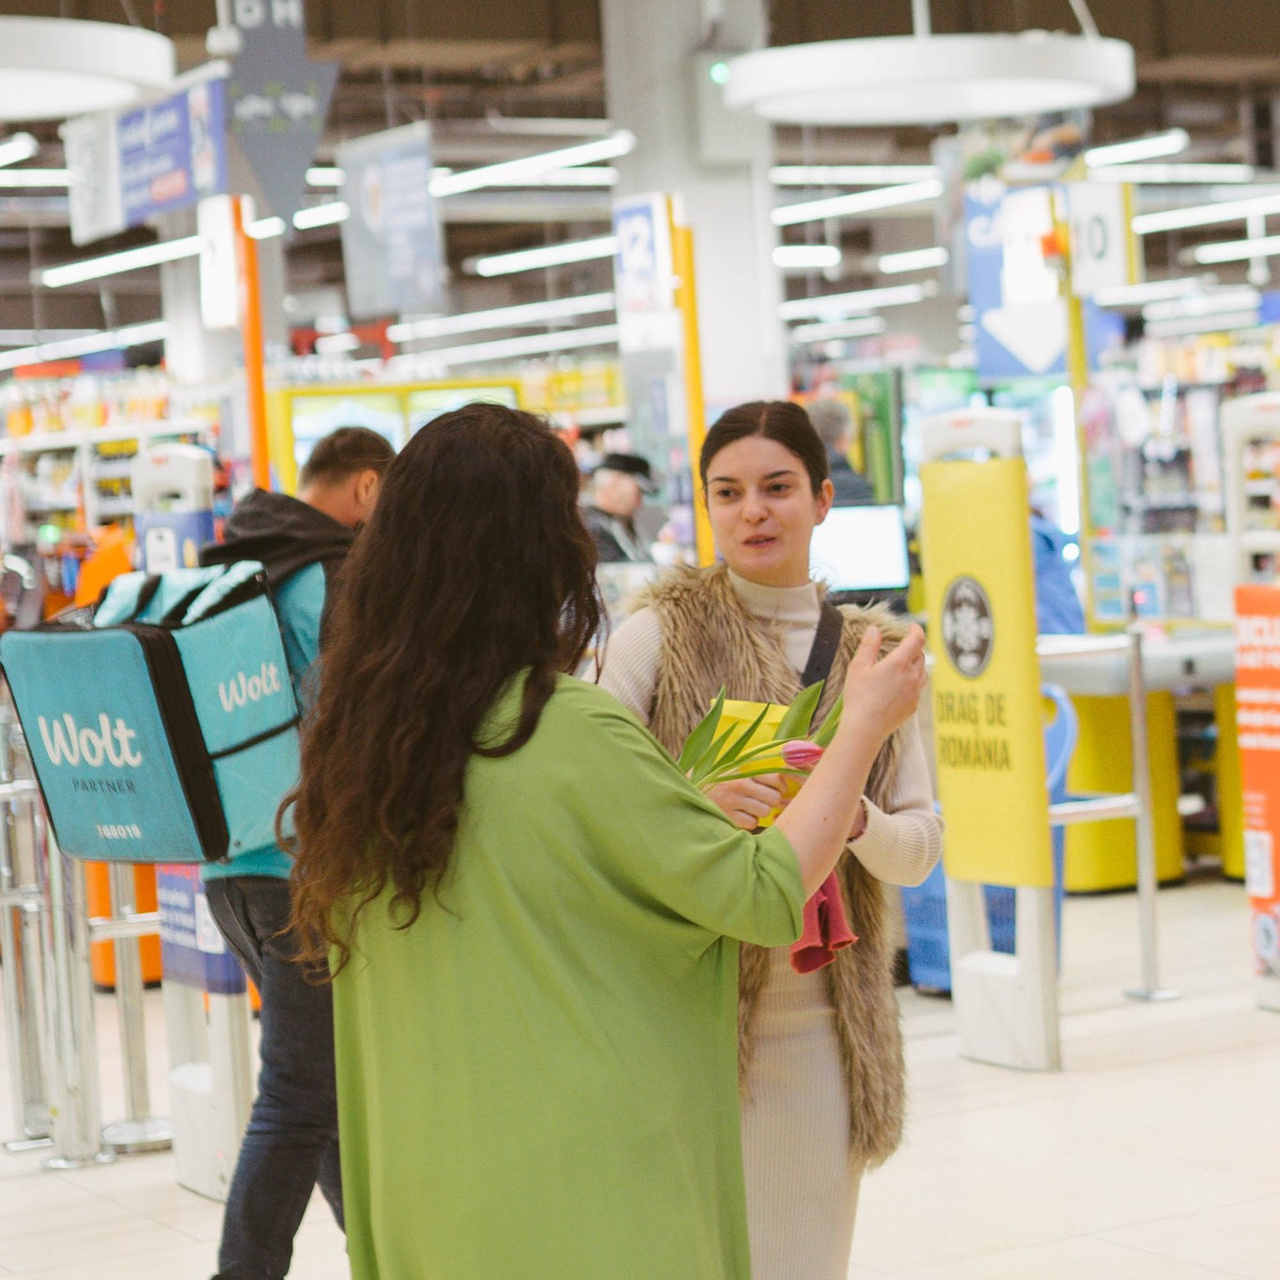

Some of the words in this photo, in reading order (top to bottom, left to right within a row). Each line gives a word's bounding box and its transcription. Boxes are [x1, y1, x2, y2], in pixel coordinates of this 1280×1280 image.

[218, 662, 281, 712] Wolt
[936, 691, 979, 726] DRAG
[985, 693, 1006, 727] DE
[37, 713, 142, 767] Wolt
[72, 778, 137, 795] PARTNER
